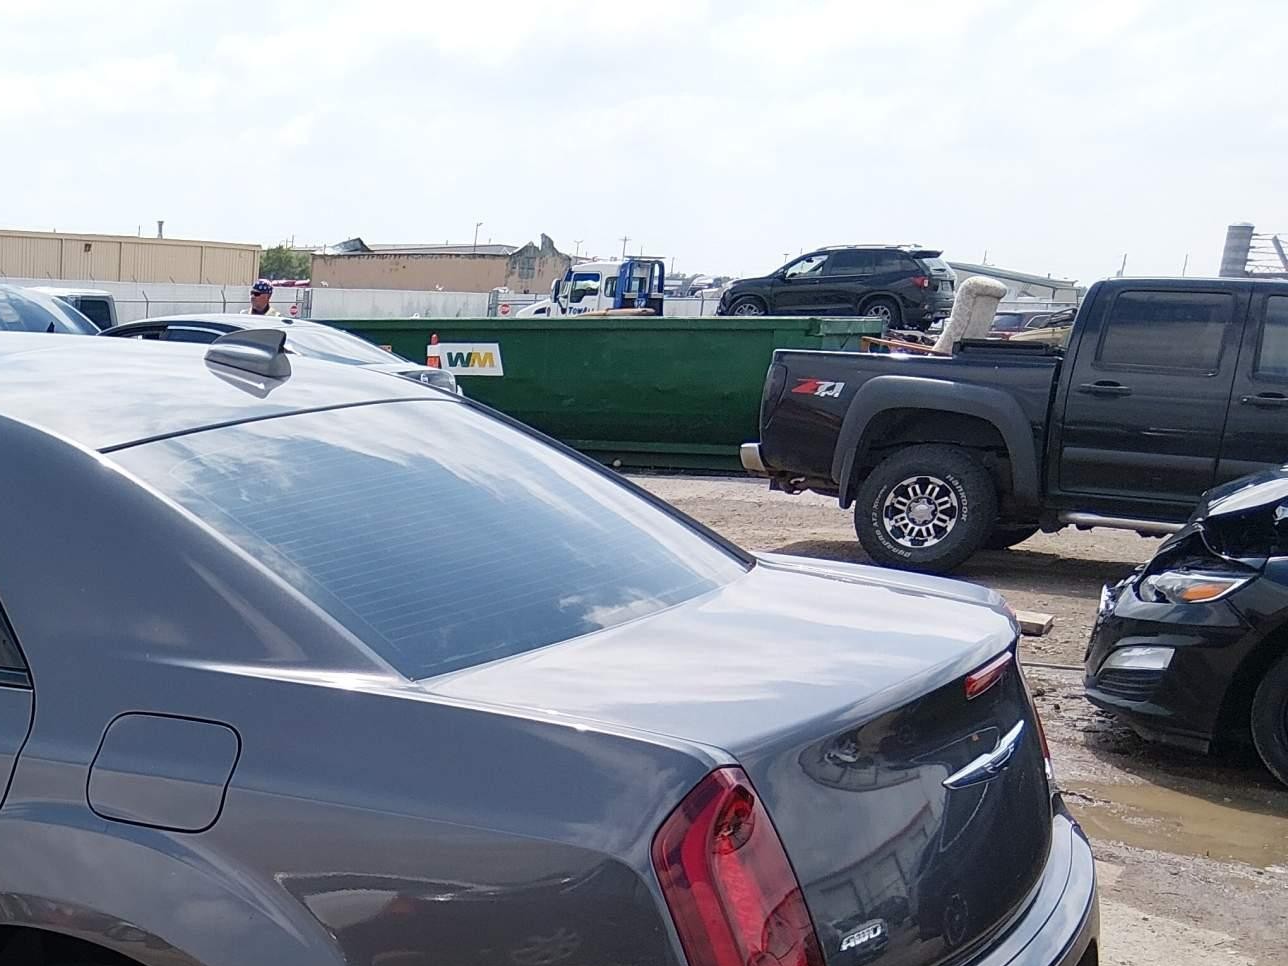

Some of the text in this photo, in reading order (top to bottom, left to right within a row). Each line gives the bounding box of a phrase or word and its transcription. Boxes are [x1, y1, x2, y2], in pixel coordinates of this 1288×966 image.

[446, 352, 495, 368] WM
[791, 378, 845, 398] Z71
[840, 923, 882, 951] AWD
